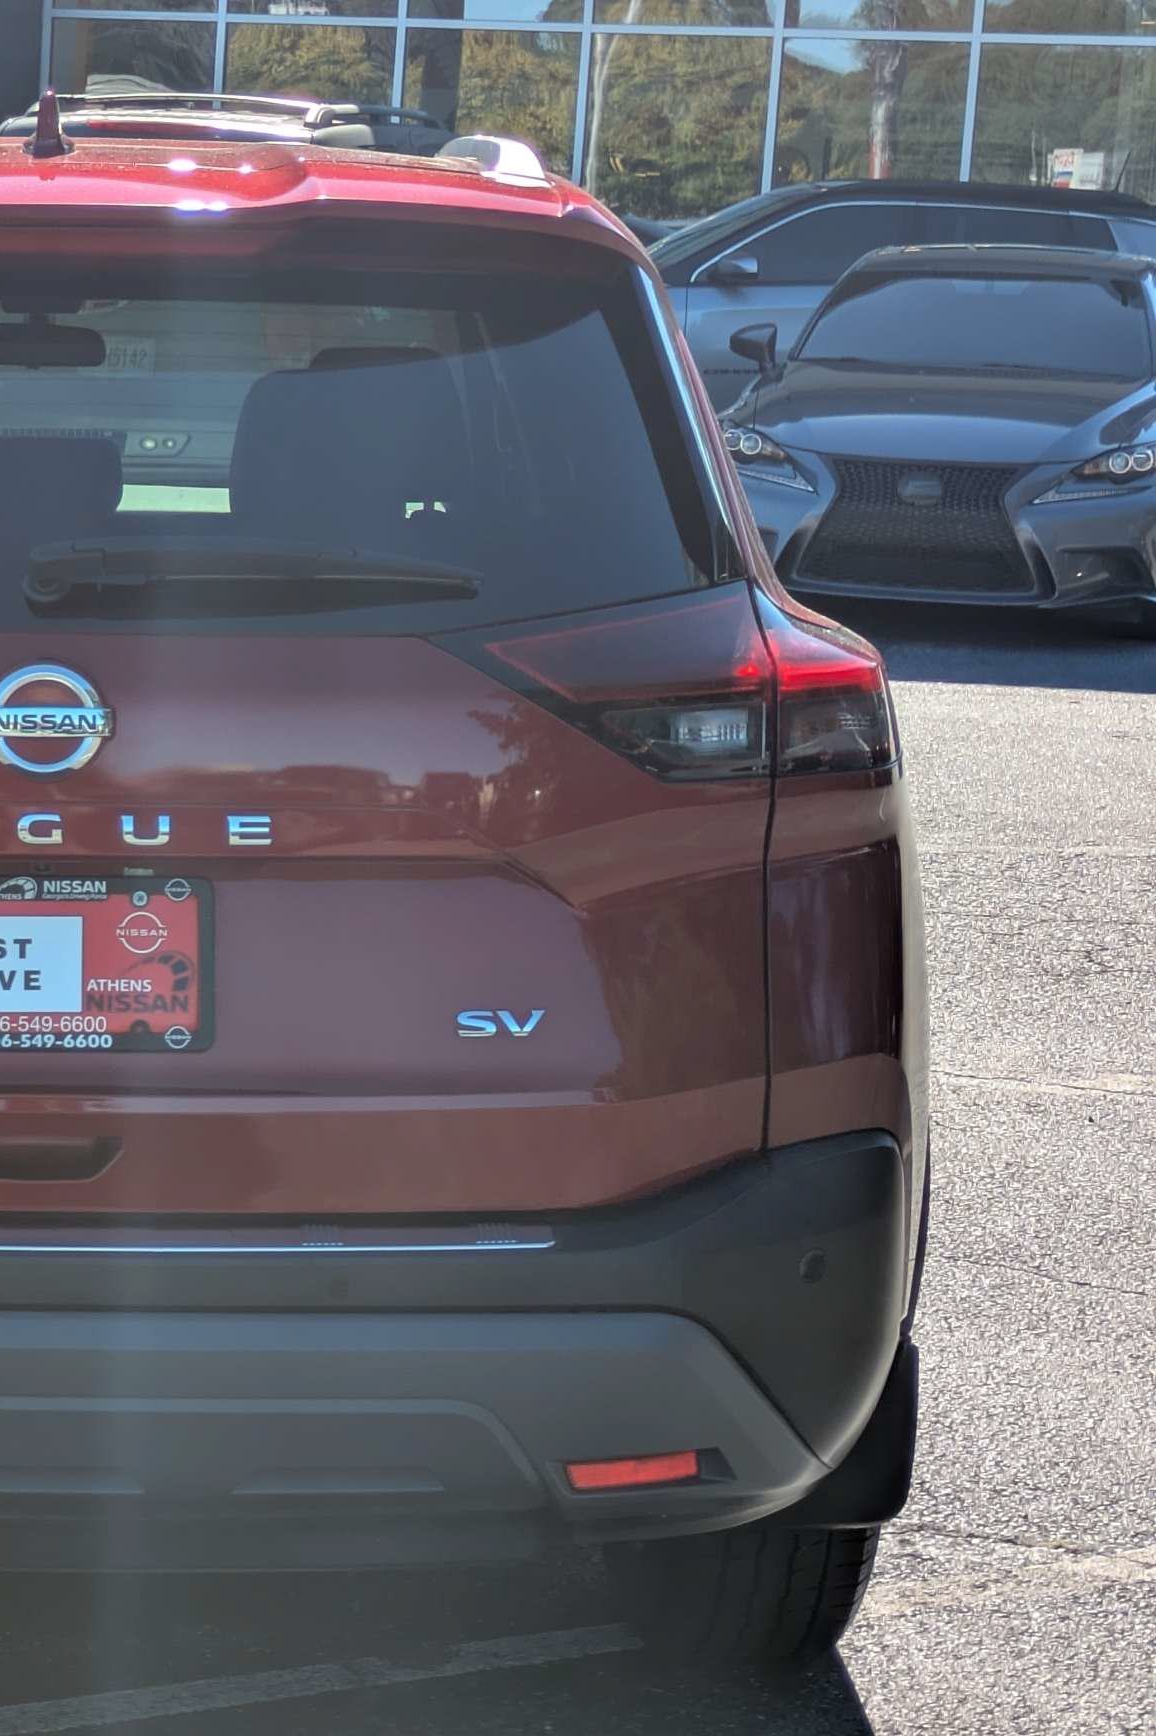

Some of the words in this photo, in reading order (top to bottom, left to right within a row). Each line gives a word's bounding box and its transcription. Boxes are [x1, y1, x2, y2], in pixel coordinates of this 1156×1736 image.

[43, 880, 107, 893] NISSAN
[115, 928, 169, 937] NISSAN
[87, 978, 153, 992] ATHENS
[86, 994, 189, 1013] NISSAN
[457, 1009, 546, 1037] SV
